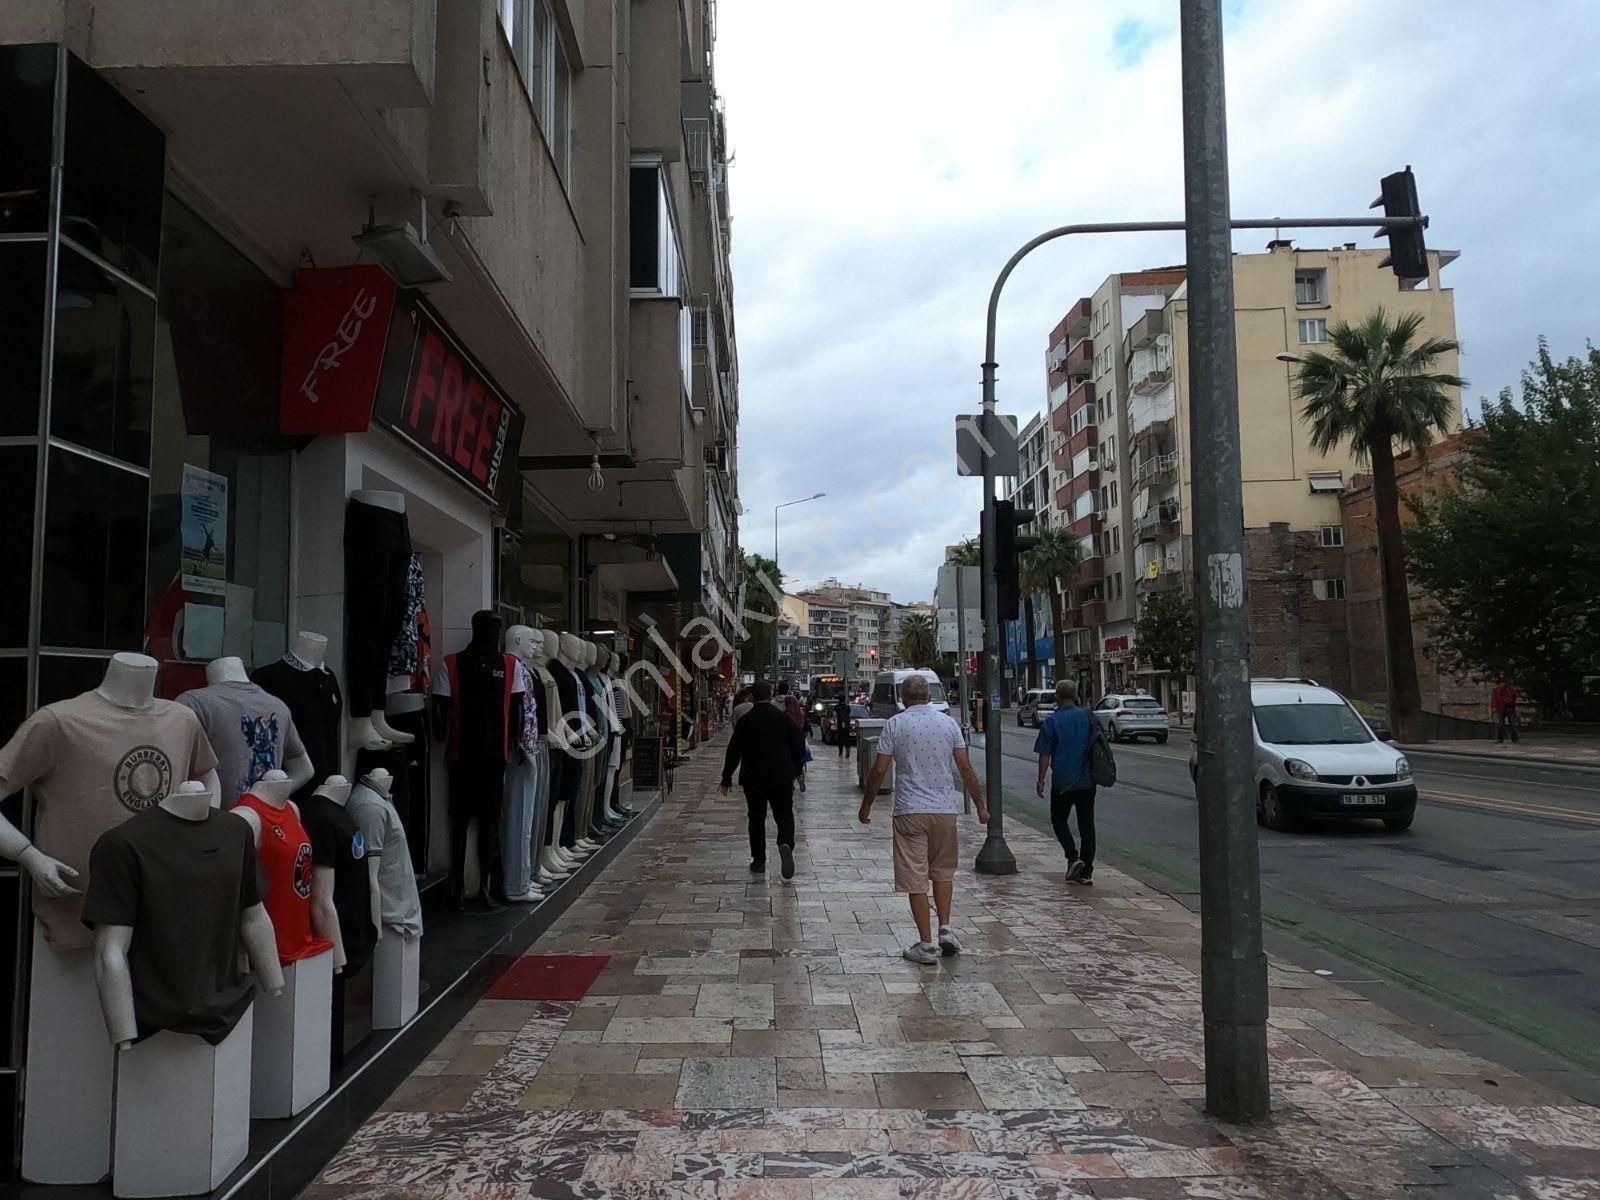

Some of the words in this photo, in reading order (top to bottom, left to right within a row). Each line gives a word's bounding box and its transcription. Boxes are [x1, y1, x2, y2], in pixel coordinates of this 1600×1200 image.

[300, 287, 377, 404] FREE
[408, 330, 502, 484] FREE
[486, 406, 510, 493] DENIM
[122, 790, 165, 809] ENGLAND
[124, 750, 169, 773] BURBERRY
